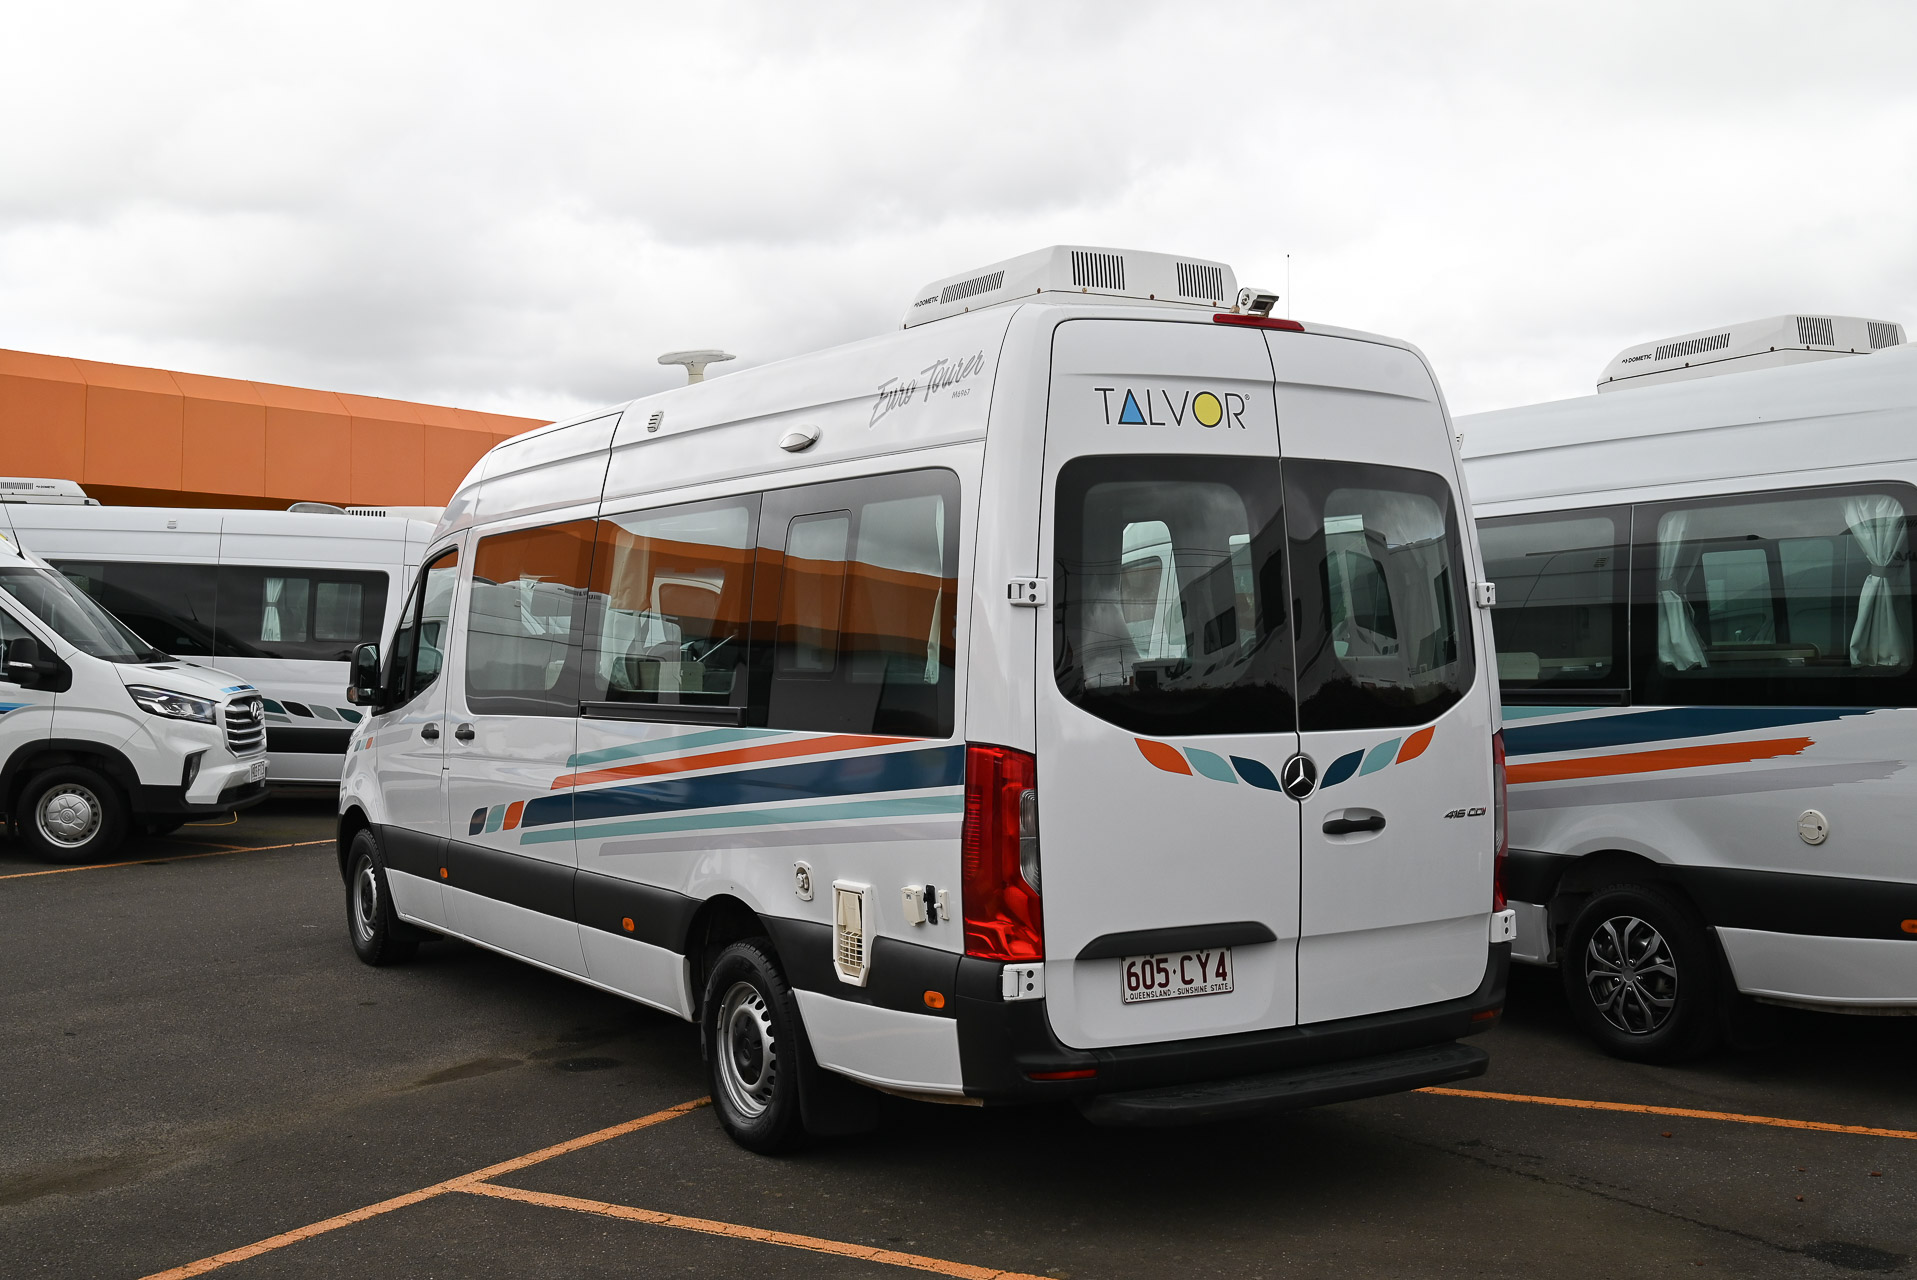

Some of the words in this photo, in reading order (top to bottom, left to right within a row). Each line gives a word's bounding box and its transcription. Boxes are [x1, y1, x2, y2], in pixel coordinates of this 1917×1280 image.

[919, 295, 939, 307] DOMETIC
[1628, 353, 1652, 363] DOMETIC
[869, 376, 917, 428] Euro
[920, 350, 985, 403] Tourer
[1443, 809, 1466, 819] 416
[1467, 807, 1487, 817] CDI
[1129, 988, 1171, 1001] QUEENSLAND
[1177, 984, 1208, 996] SUNSHINE
[1210, 982, 1228, 992] STATE
